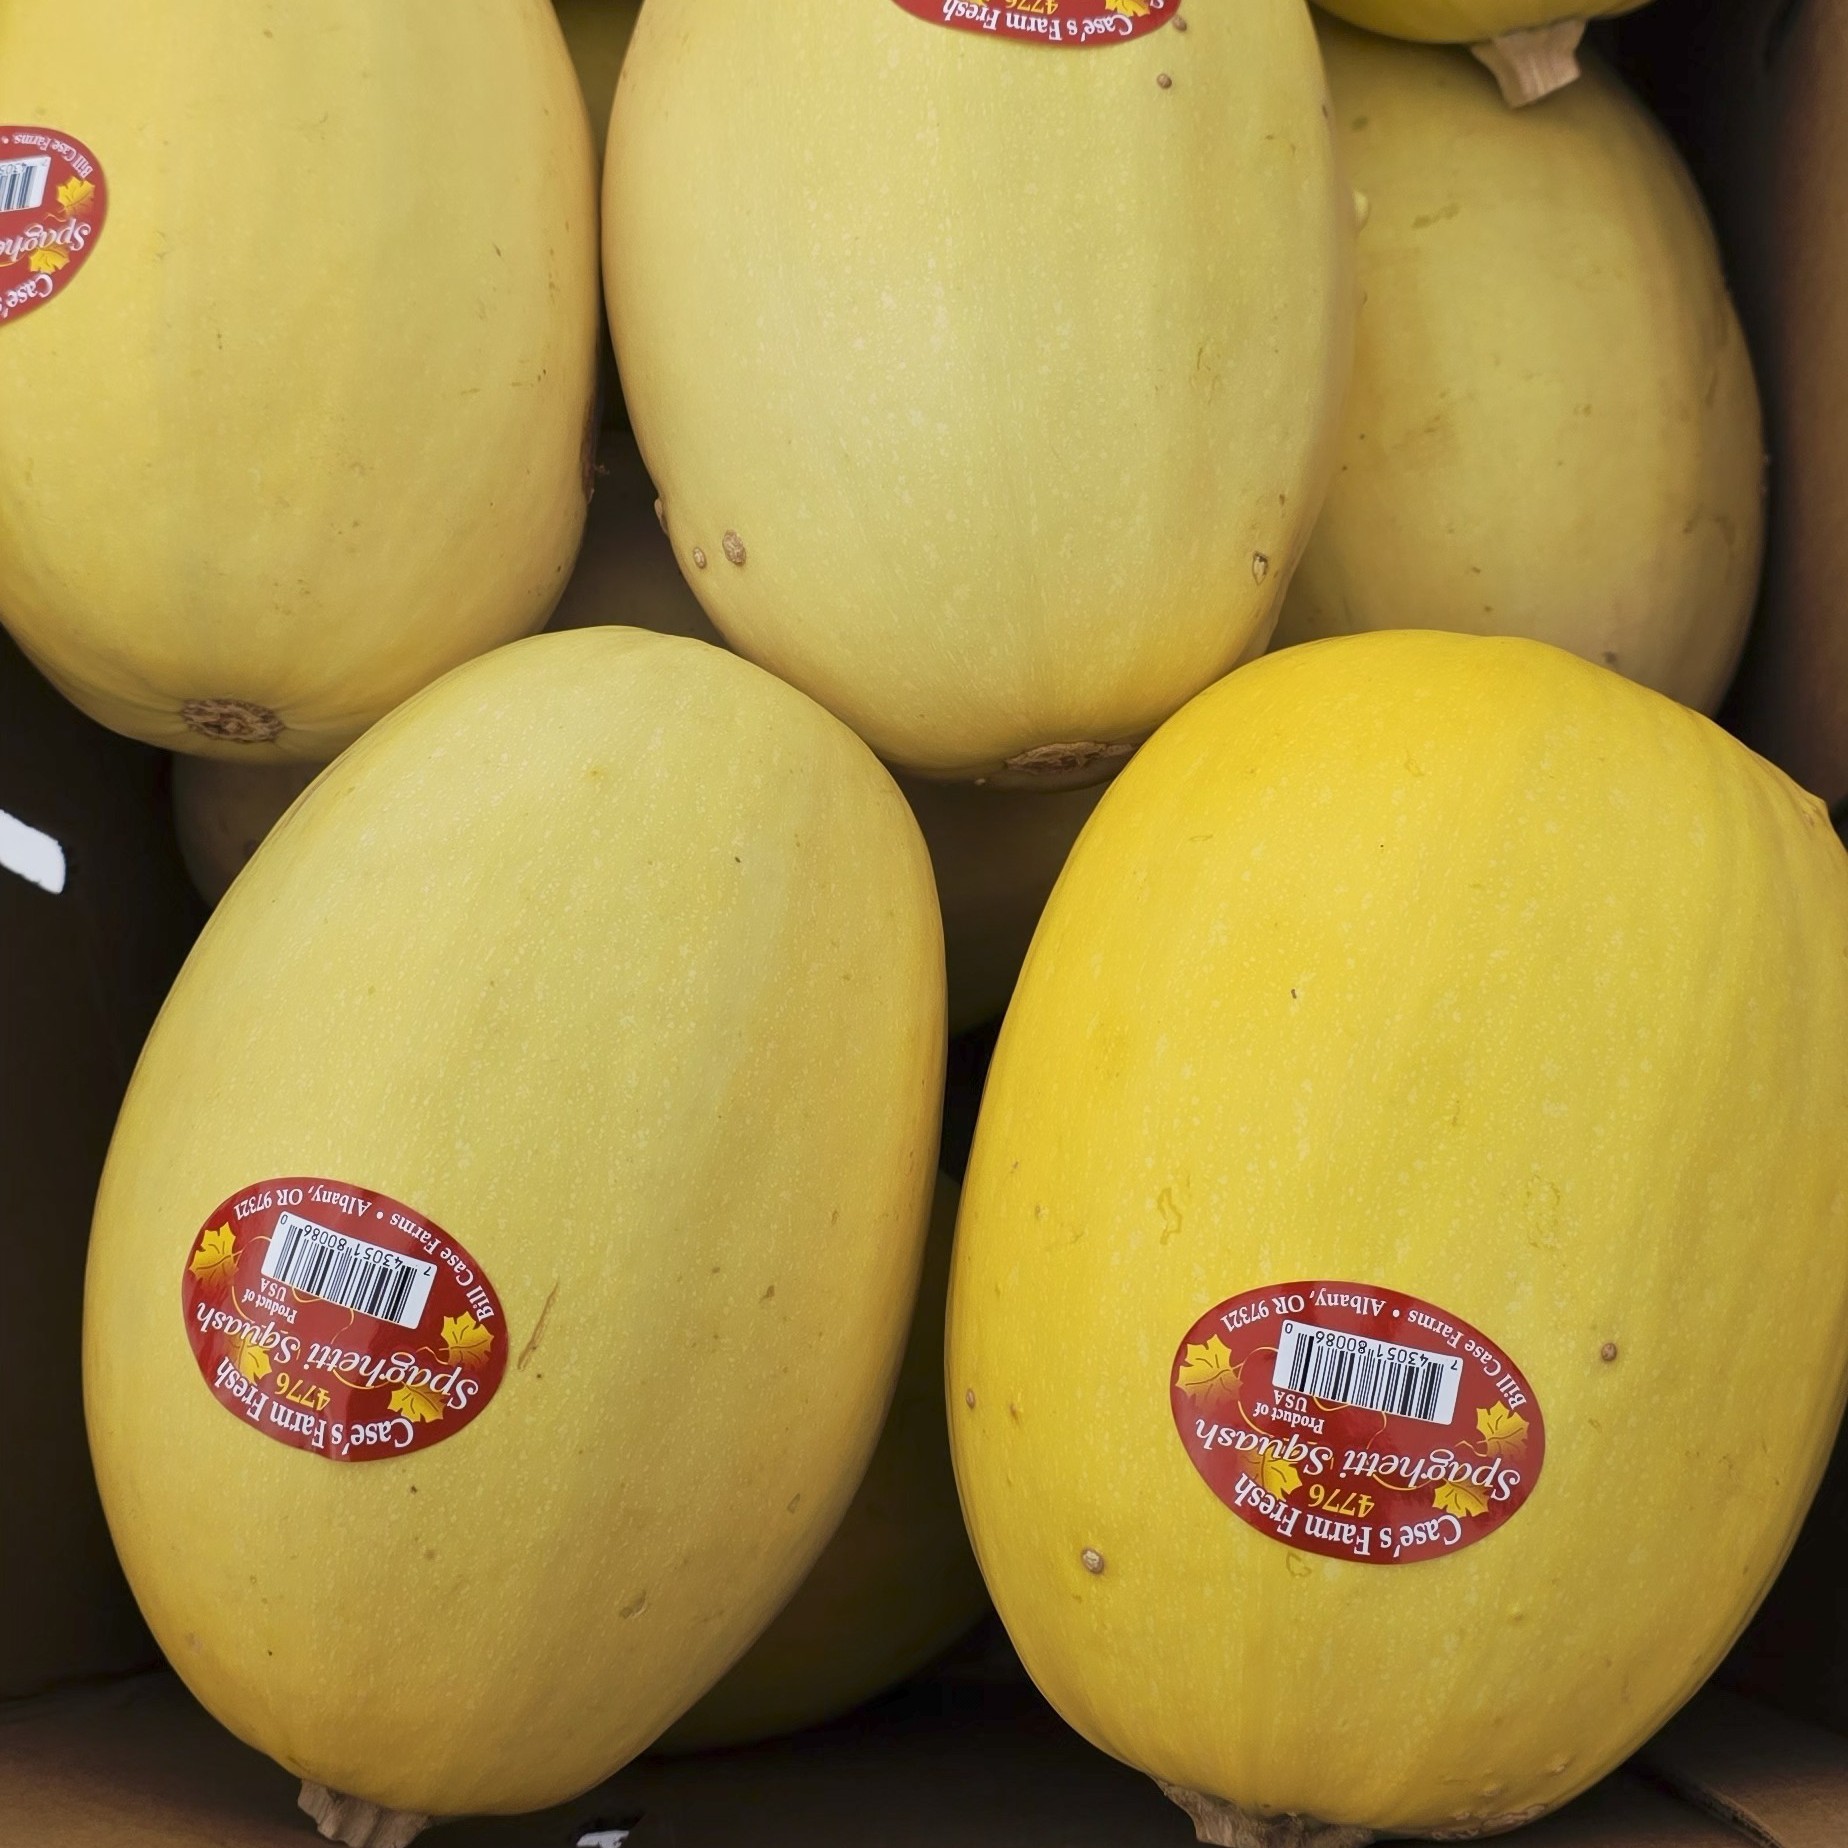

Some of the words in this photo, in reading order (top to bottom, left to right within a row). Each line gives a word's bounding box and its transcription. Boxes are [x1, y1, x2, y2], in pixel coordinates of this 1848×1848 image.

[943, 0, 1000, 30] Fresh
[1006, 13, 1062, 41] Farm
[1067, 13, 1133, 42] Case's
[13, 133, 51, 151] Farms
[51, 139, 77, 161] Case
[72, 155, 93, 179] Bill
[233, 1190, 272, 1221] 97321
[276, 1188, 303, 1206] OR
[308, 1185, 372, 1217] Albany,
[280, 1214, 288, 1225] 0
[390, 1213, 441, 1254] Farms
[304, 1225, 346, 1250] 80086
[354, 1243, 403, 1268] 43051
[439, 1252, 474, 1284] Case
[423, 1266, 431, 1276] 7
[242, 1289, 256, 1304] of
[260, 1278, 286, 1300] USA
[467, 1285, 495, 1322] Bill
[1309, 1288, 1386, 1317] Albany,
[256, 1295, 298, 1324] Product
[1220, 1302, 1269, 1332] 97321
[1272, 1294, 1305, 1314] OR
[197, 1302, 301, 1363] Squash
[1284, 1323, 1294, 1334] 0
[1315, 1331, 1368, 1354] 80086
[1408, 1309, 1464, 1349] Farms
[1376, 1344, 1429, 1368] 43051
[1450, 1359, 1458, 1371] 7
[1463, 1338, 1502, 1376] Case
[214, 1356, 269, 1421] Fresh
[303, 1343, 478, 1410] Spaghetti
[1498, 1372, 1527, 1410] Bill
[275, 1373, 331, 1411] 4776
[1273, 1389, 1307, 1412] USA
[1252, 1402, 1271, 1417] of
[1271, 1408, 1325, 1434] Product
[271, 1403, 327, 1448] Farm
[331, 1418, 414, 1455] Case's
[1195, 1418, 1333, 1476] Squash
[1340, 1448, 1521, 1501] Spaghetti
[1234, 1472, 1301, 1537] Fresh
[1308, 1483, 1375, 1518] 4776
[1304, 1514, 1371, 1556] Farm
[1380, 1514, 1462, 1558] Case's
